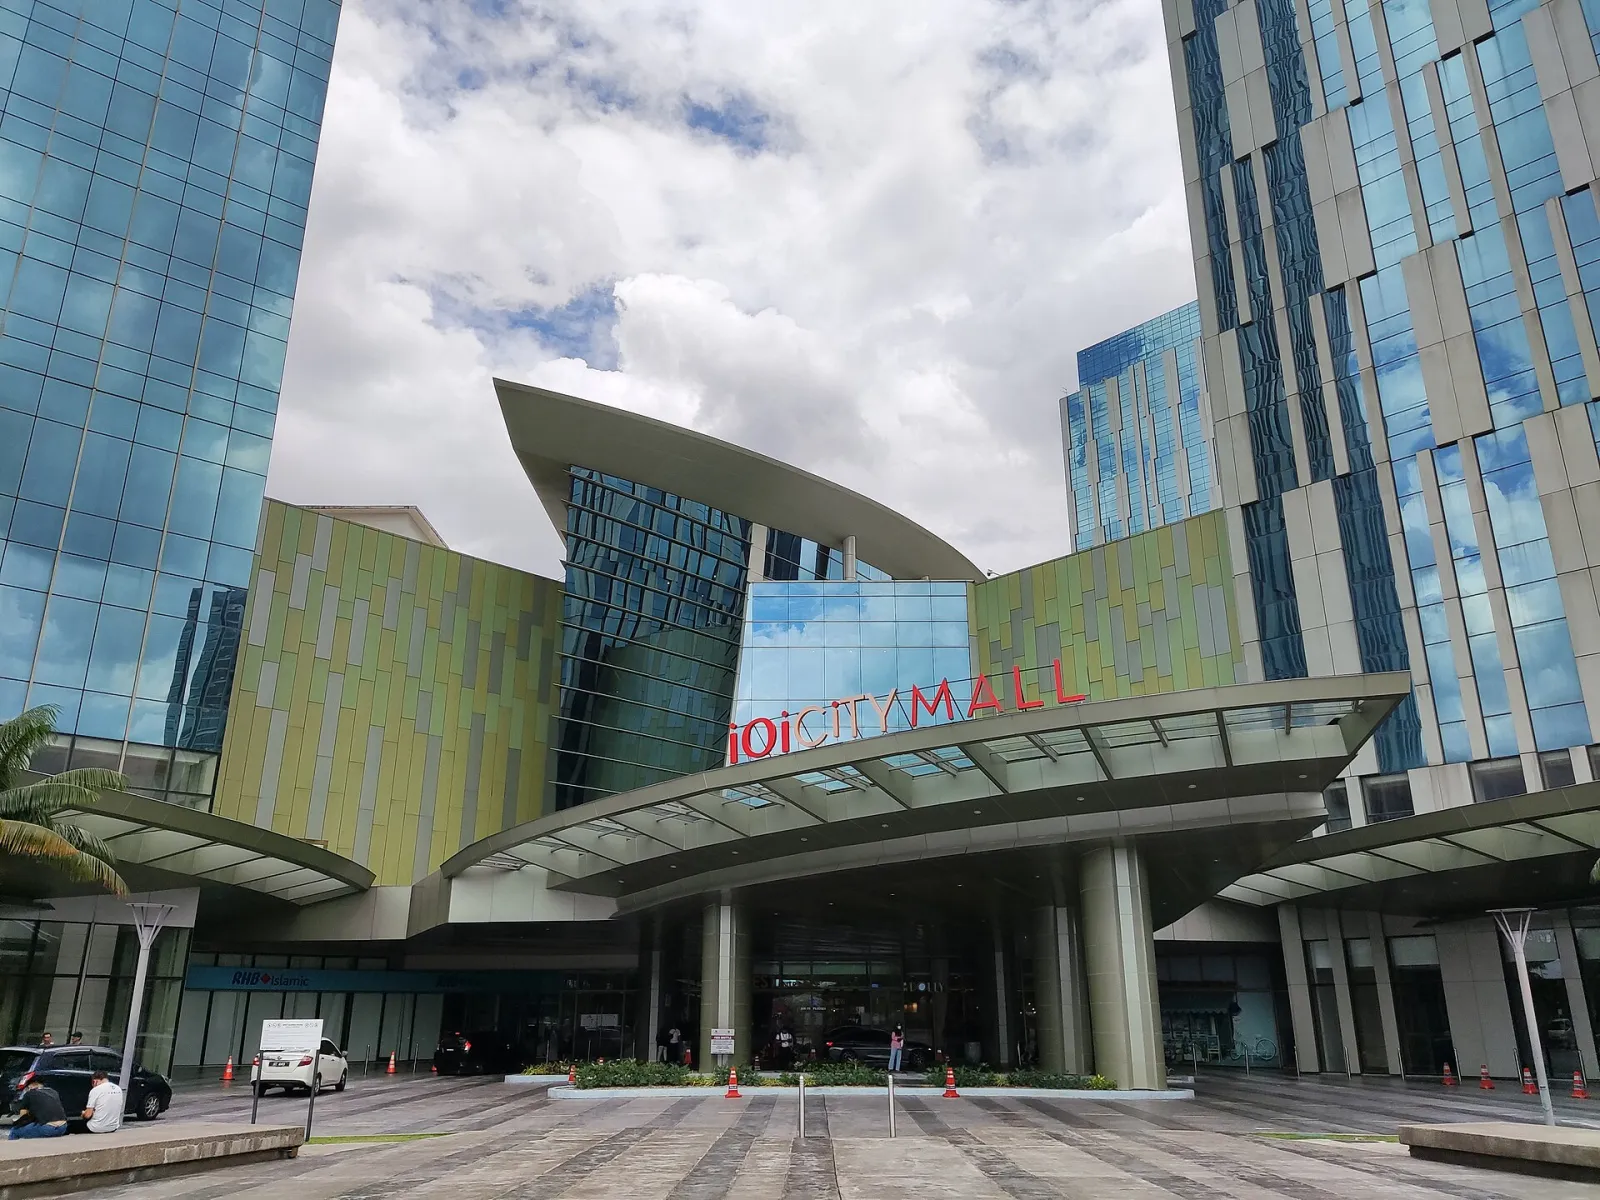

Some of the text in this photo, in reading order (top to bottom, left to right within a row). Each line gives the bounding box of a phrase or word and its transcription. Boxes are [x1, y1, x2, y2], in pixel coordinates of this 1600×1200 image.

[911, 658, 1086, 728] MALL
[232, 971, 310, 986] RHB Islamic
